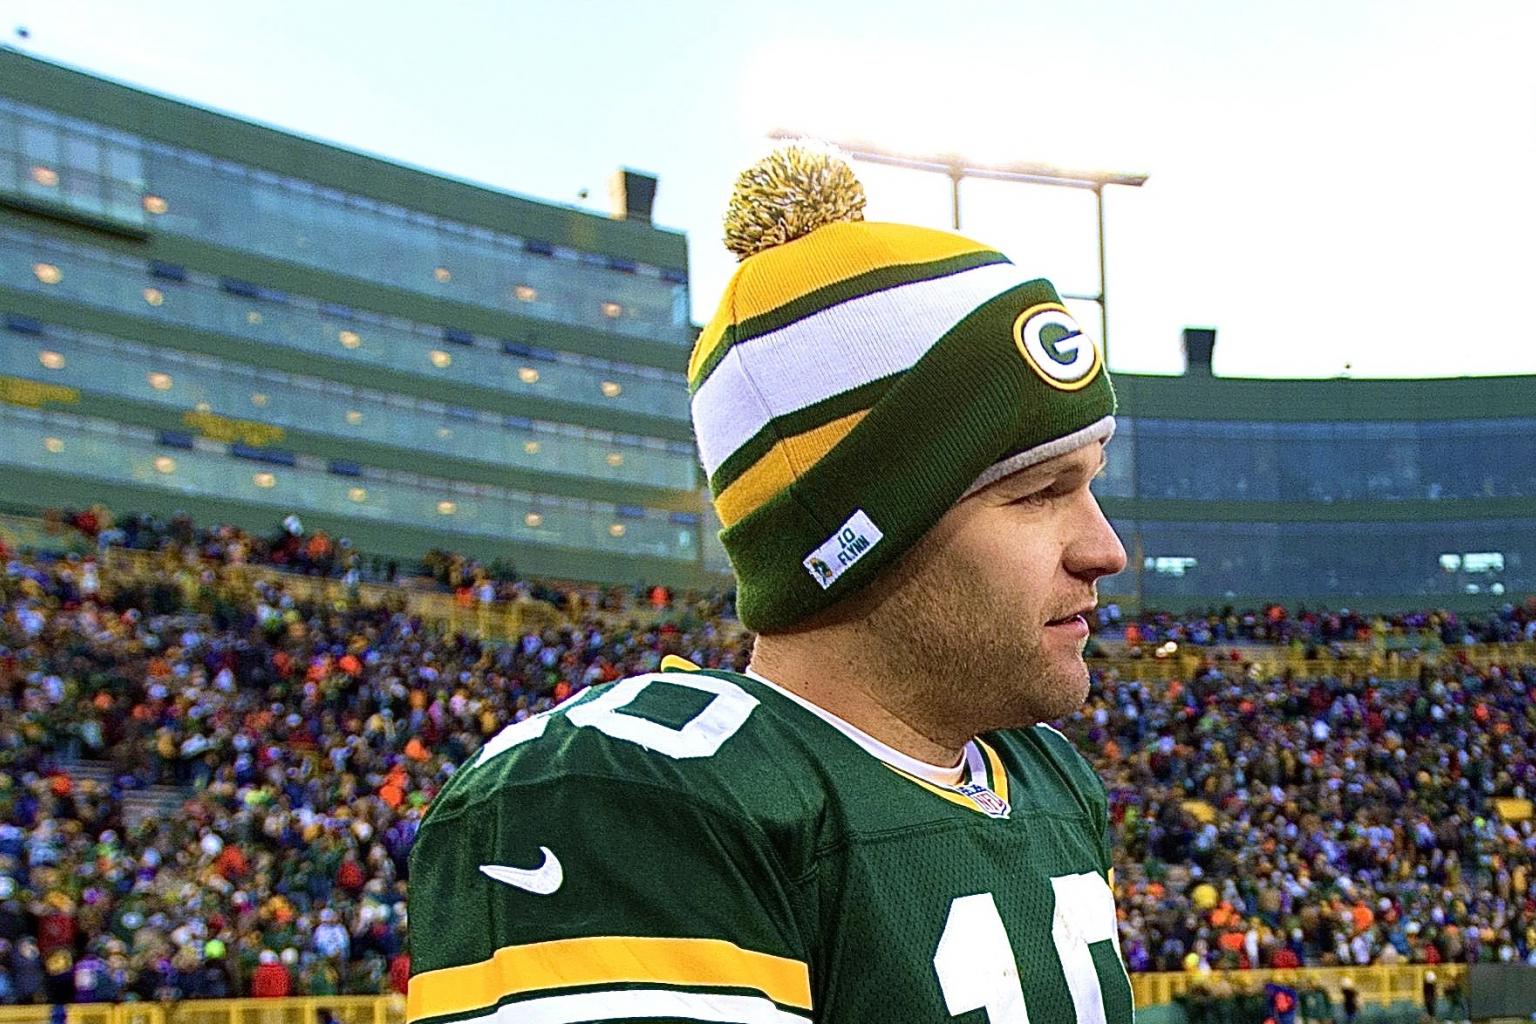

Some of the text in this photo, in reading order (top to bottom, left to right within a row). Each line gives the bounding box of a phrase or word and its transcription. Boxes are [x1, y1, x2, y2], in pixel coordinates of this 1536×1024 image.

[1020, 307, 1099, 383] G
[837, 527, 856, 550] 10
[837, 534, 870, 566] FLYNN
